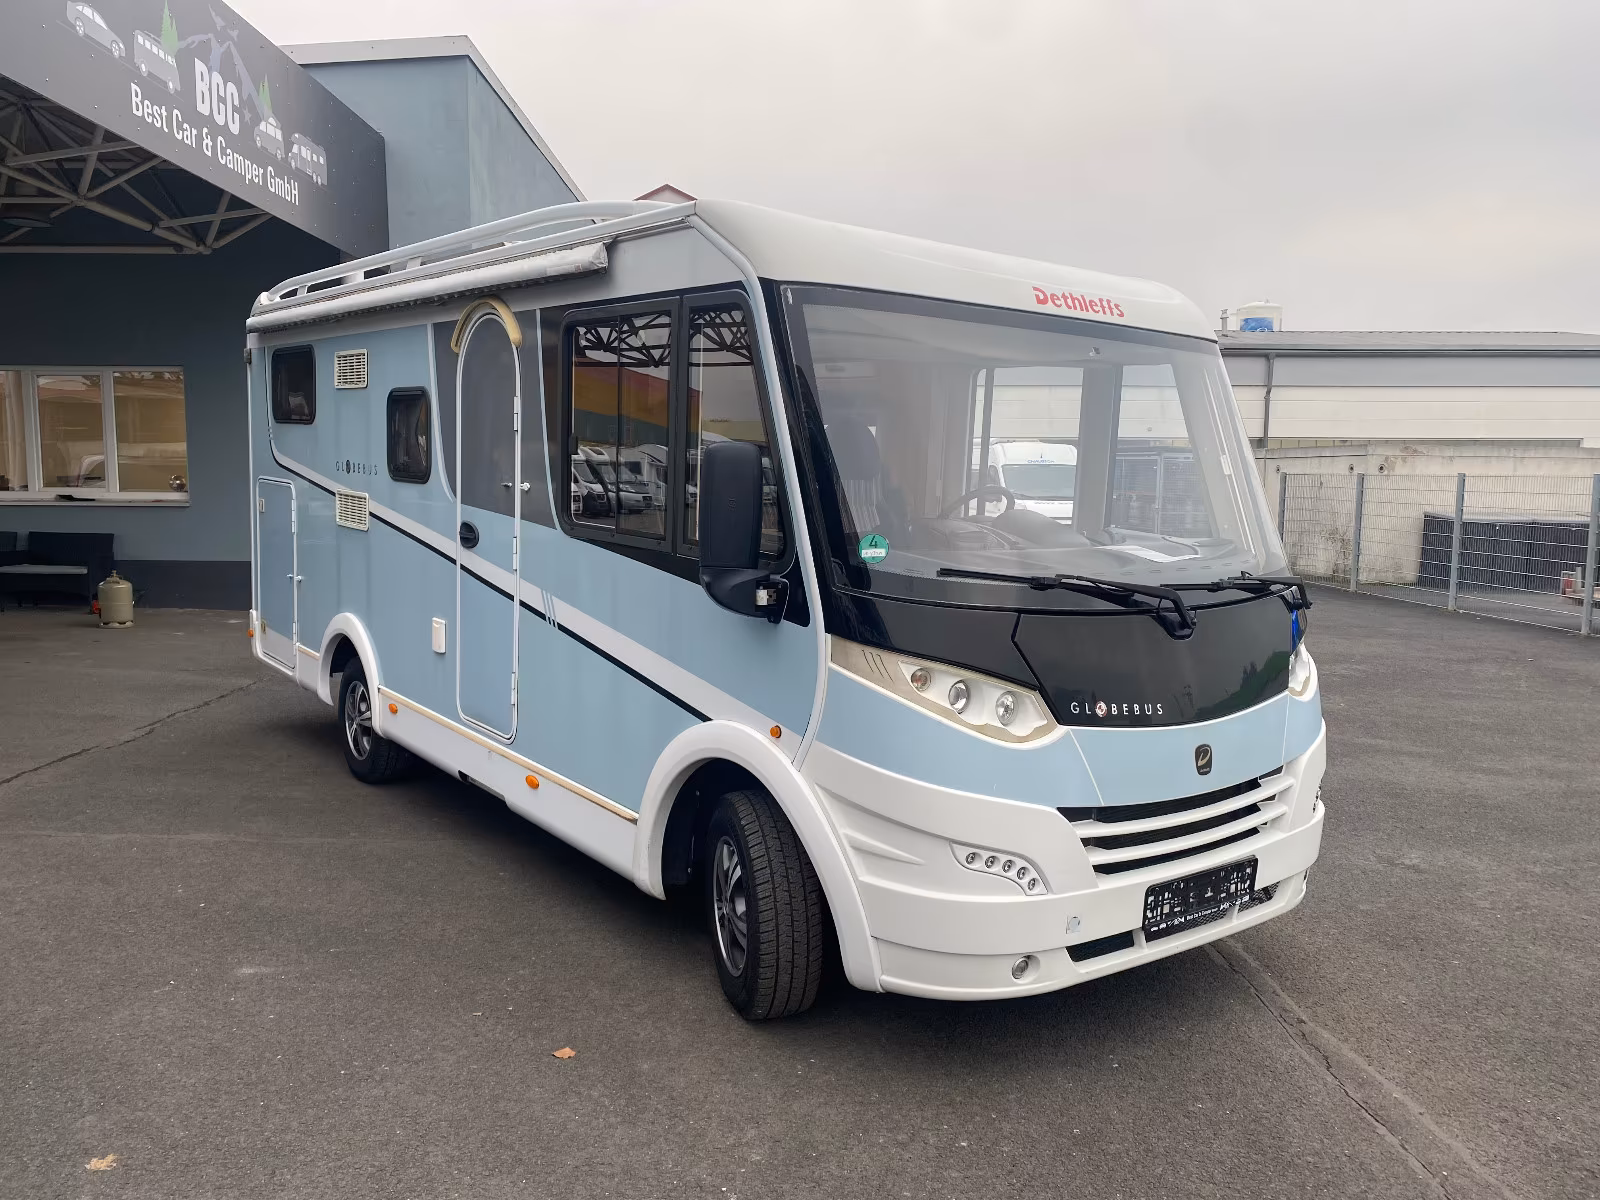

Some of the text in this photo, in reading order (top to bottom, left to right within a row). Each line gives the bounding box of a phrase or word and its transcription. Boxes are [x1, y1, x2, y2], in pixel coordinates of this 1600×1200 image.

[194, 57, 240, 135] BCC
[130, 82, 299, 205] Best Car & Camper GmbH
[1032, 286, 1125, 318] Dethleffs
[869, 535, 878, 549] 4
[1070, 700, 1163, 718] GLOBEBUS
